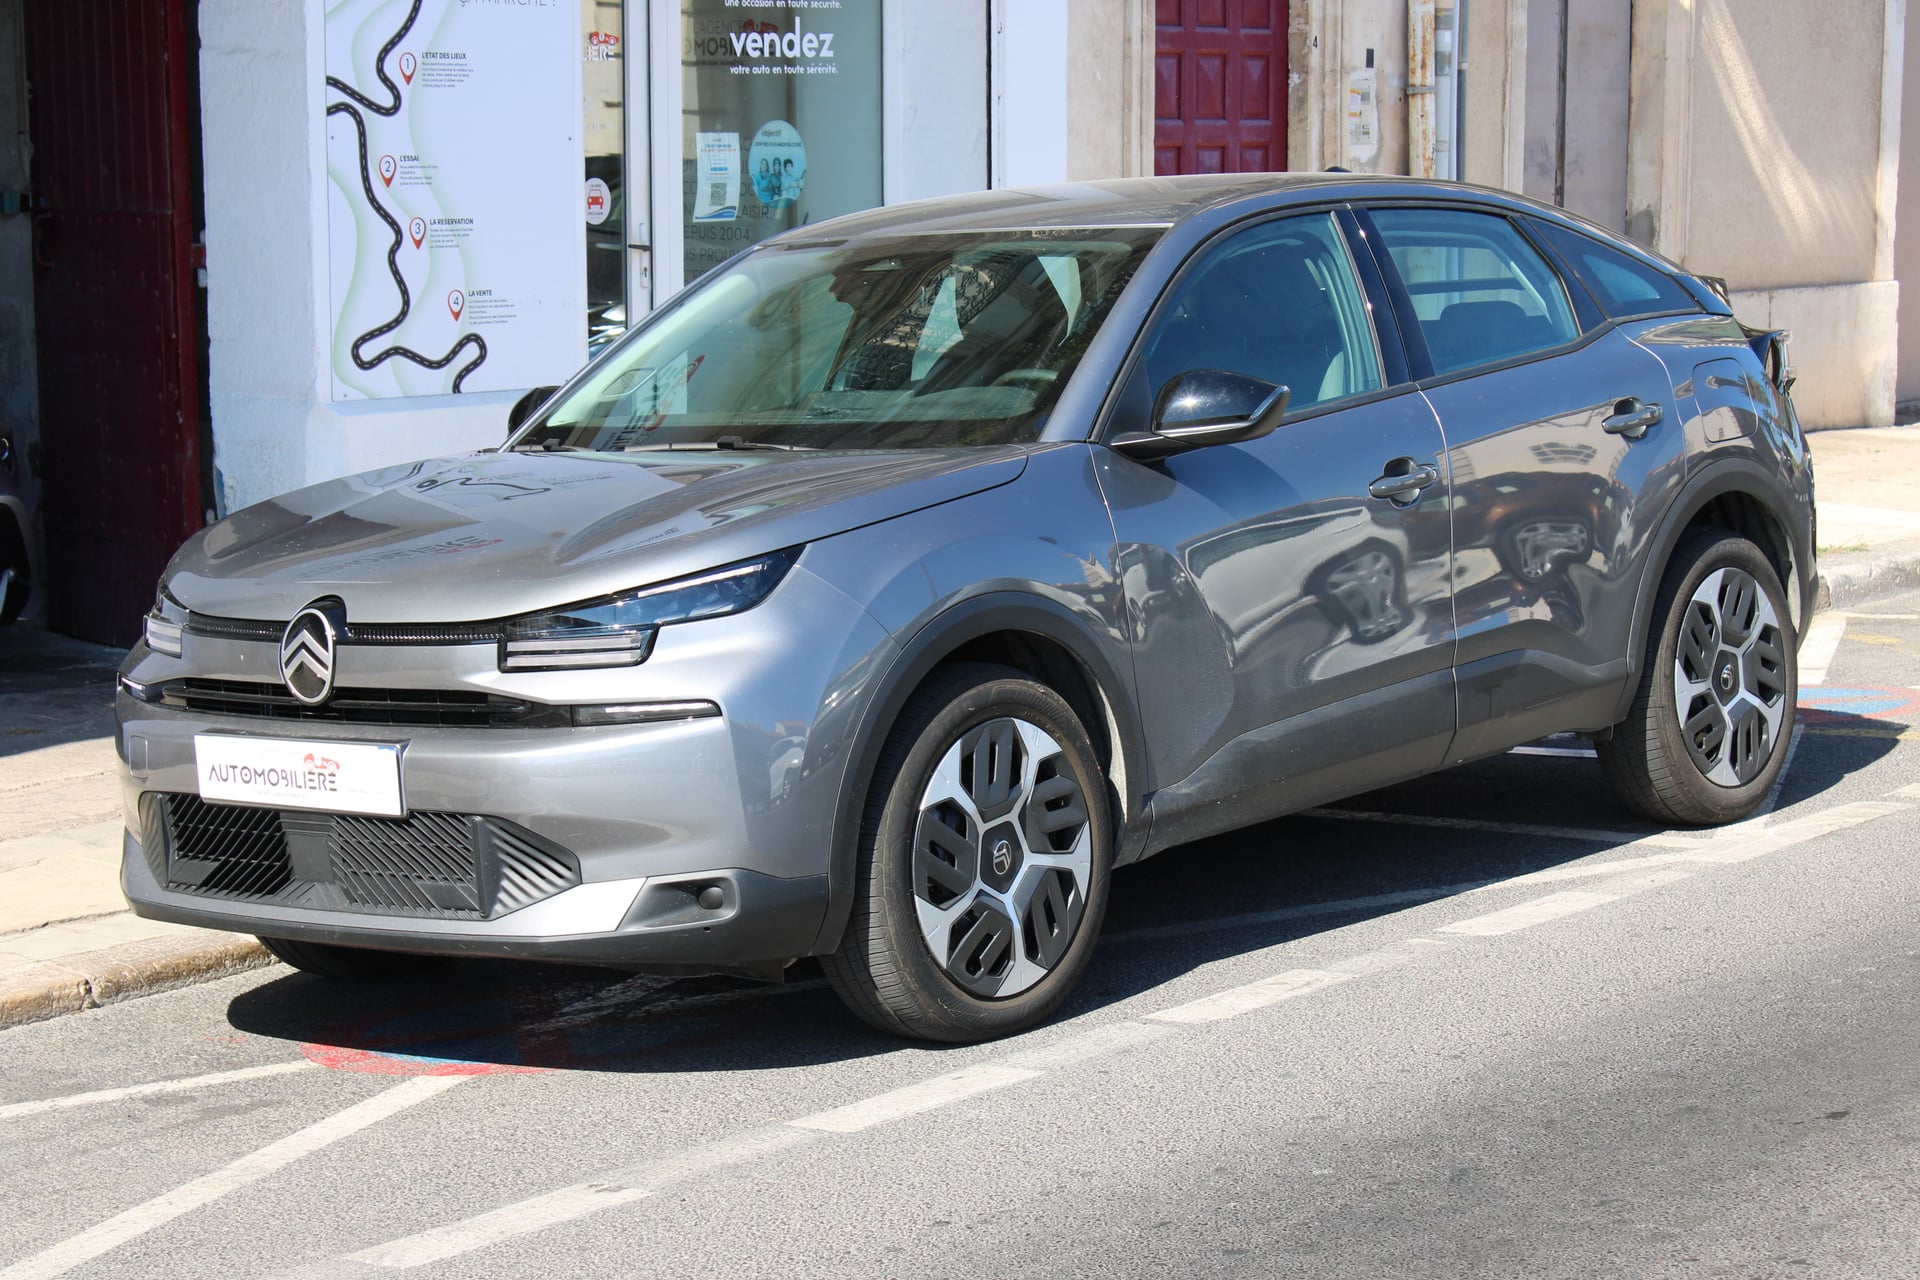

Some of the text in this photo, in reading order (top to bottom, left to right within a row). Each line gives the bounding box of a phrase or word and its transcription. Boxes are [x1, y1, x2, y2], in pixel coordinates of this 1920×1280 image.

[741, 0, 774, 8] occasion
[776, 0, 786, 8] en
[788, 0, 809, 8] toute
[730, 16, 834, 58] vendez
[1312, 35, 1318, 49] 4
[406, 58, 410, 70] 1
[730, 62, 839, 74] votre auto en toute sérénité.
[385, 160, 391, 173] 2
[415, 222, 421, 235] 3
[476, 289, 493, 297] VENTE
[453, 296, 460, 306] 4
